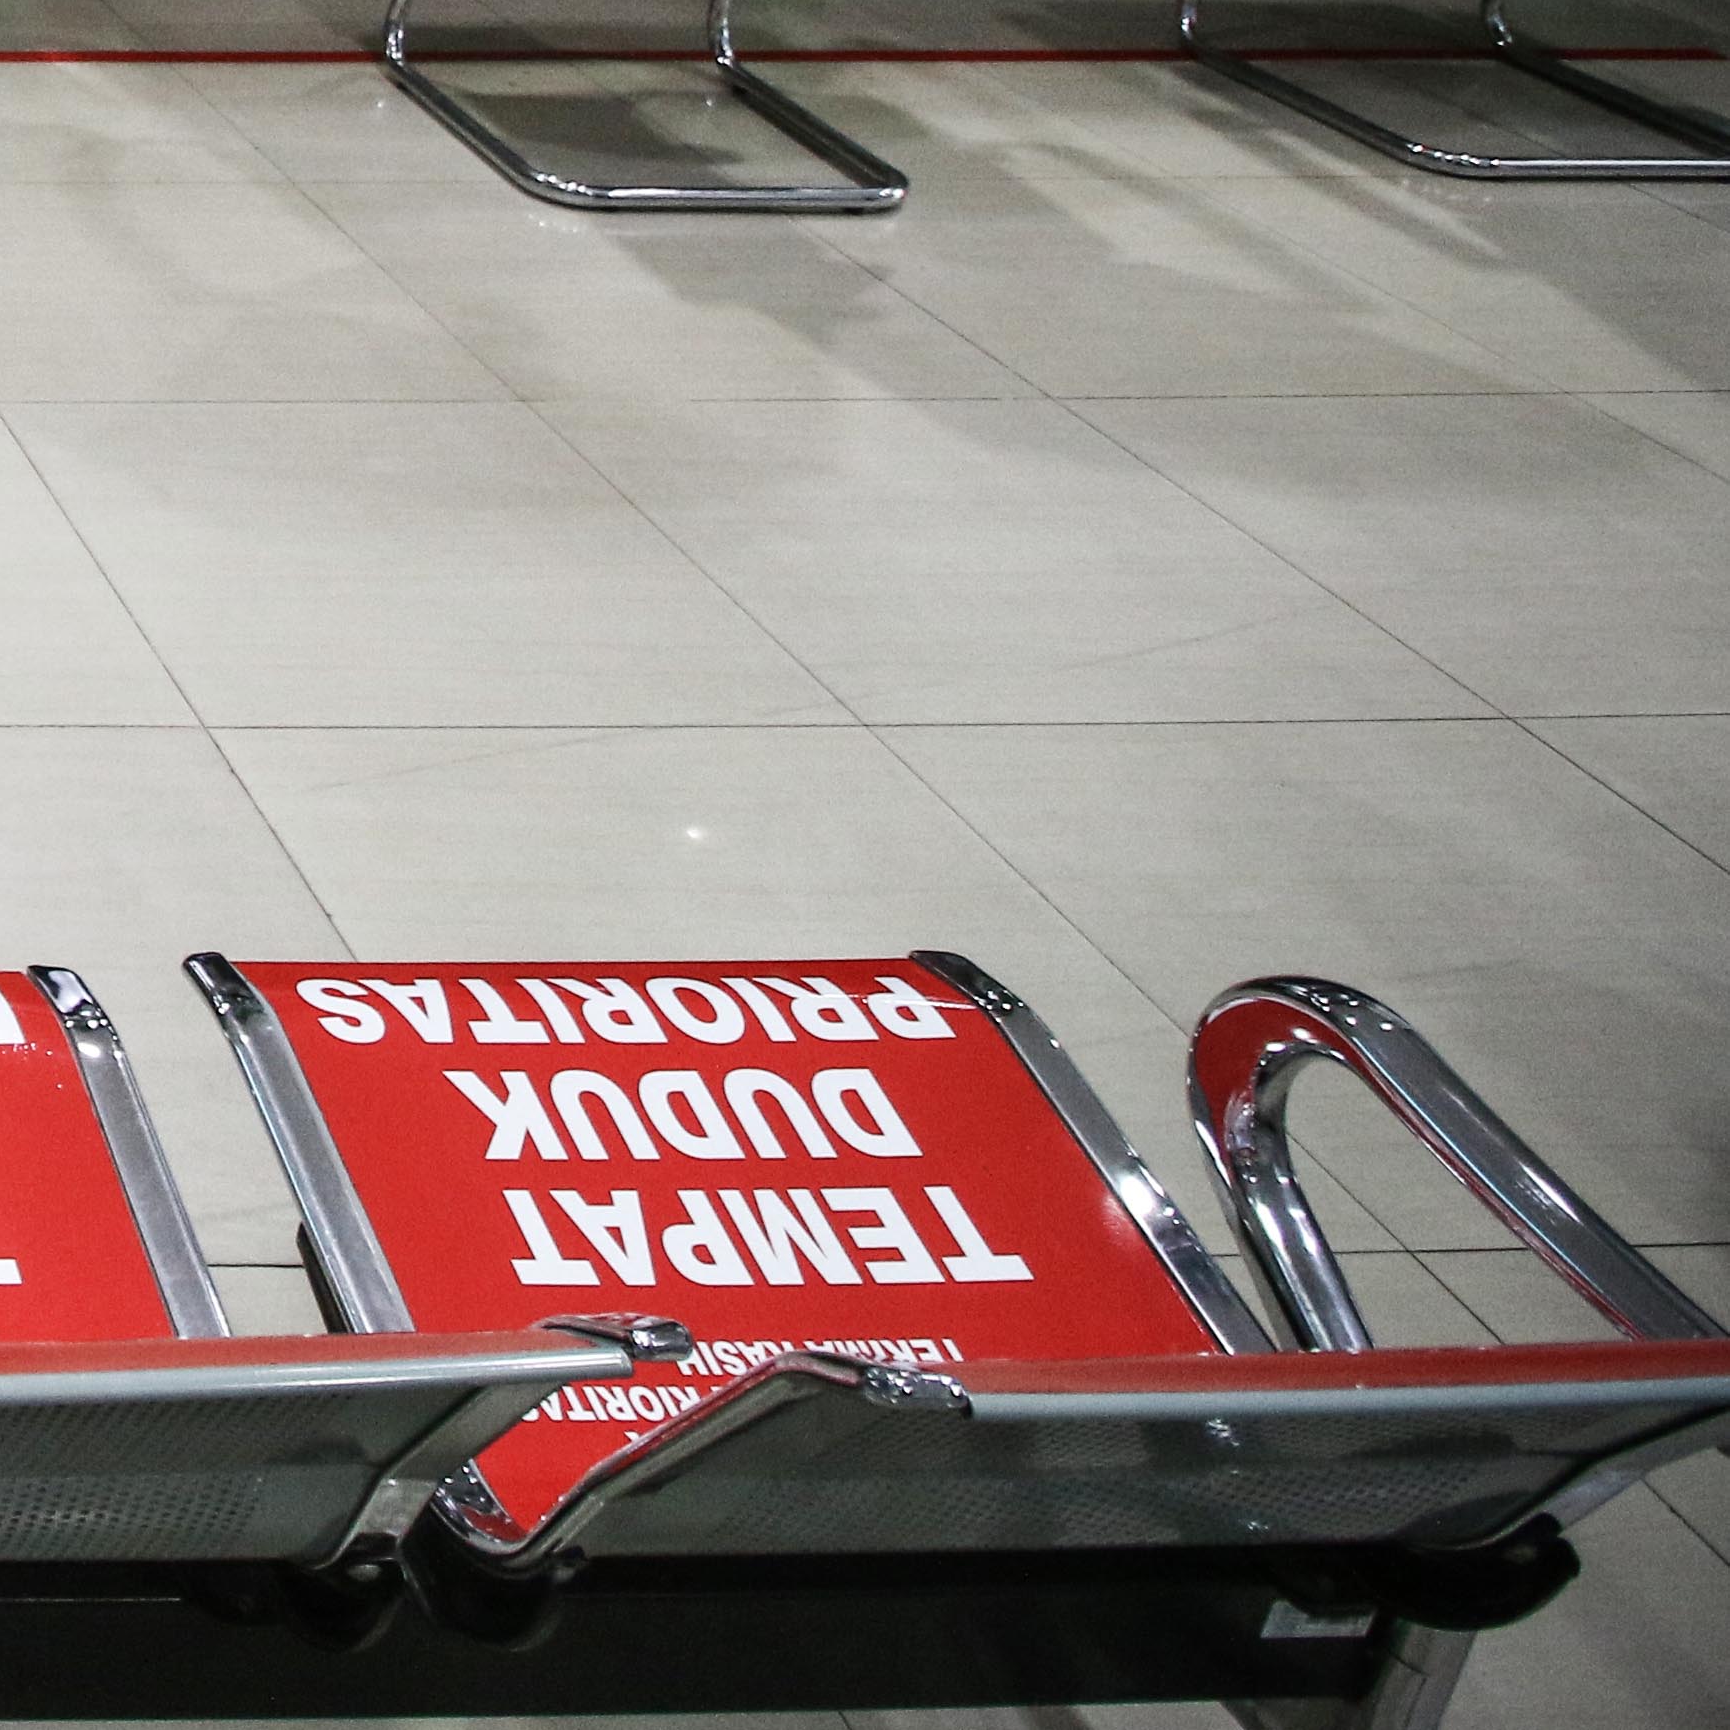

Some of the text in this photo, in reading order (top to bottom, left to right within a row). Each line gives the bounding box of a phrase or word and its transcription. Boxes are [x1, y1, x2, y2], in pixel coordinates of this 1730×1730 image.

[296, 975, 958, 1045] PRIORITAS
[442, 1067, 923, 1161] DUDUK
[501, 1185, 1035, 1287] TEMPAT
